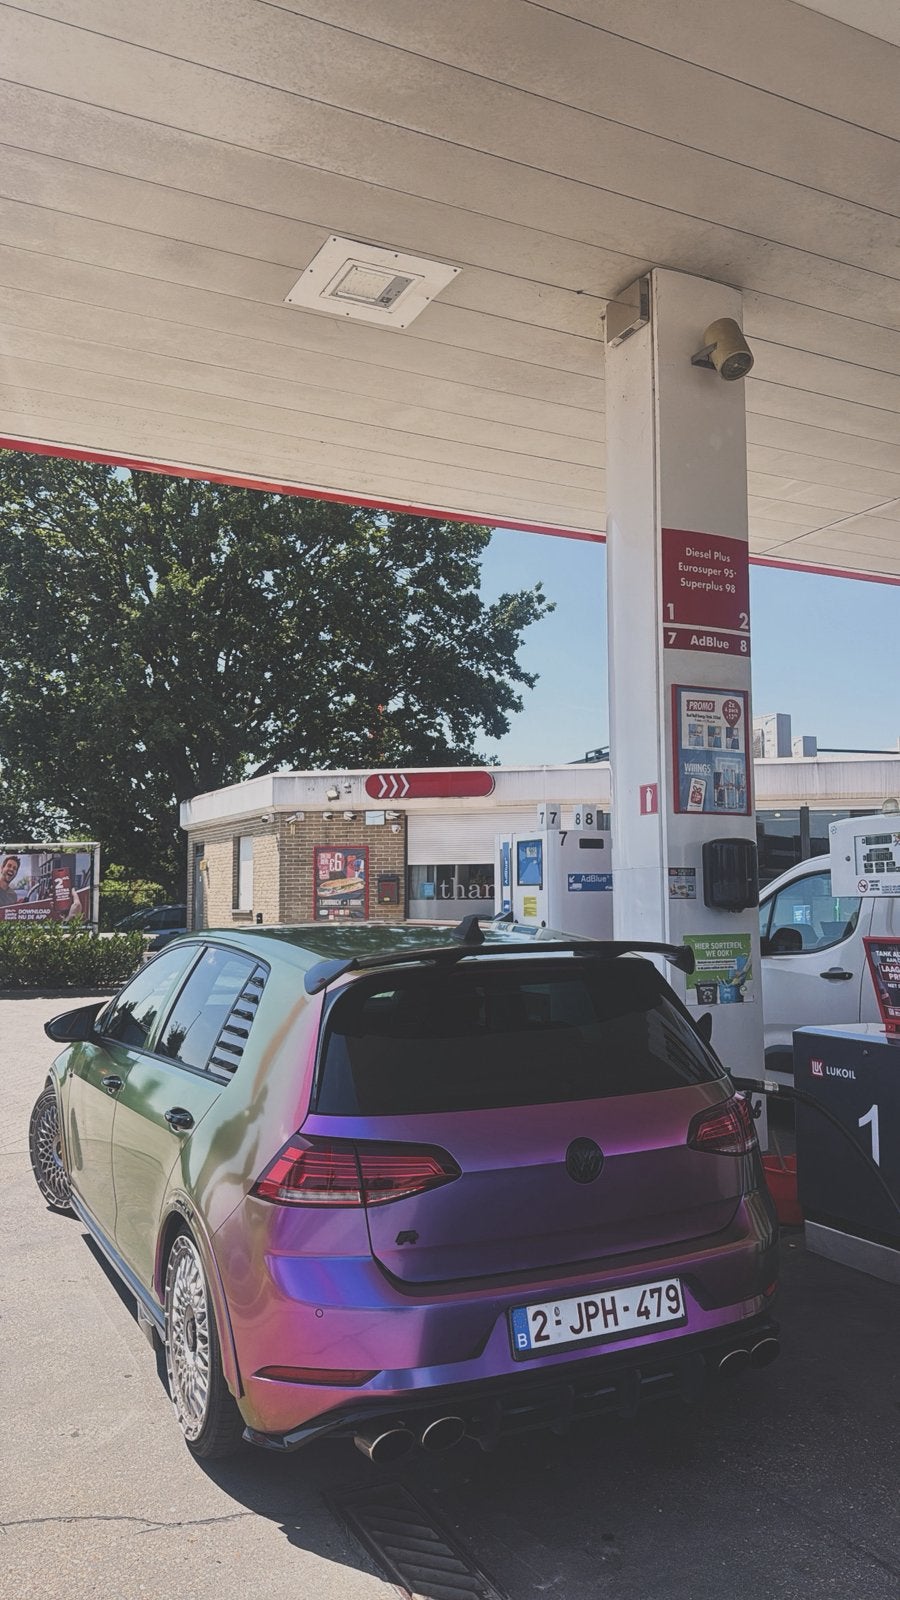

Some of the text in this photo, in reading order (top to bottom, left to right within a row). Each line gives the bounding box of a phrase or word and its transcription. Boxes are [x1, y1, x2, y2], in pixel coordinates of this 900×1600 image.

[685, 547, 731, 563] Diesel Plus
[678, 562, 722, 577] Eurosuper
[680, 578, 736, 593] Superplus 98
[666, 603, 675, 620] 1
[739, 612, 749, 630] 2
[667, 632, 748, 652] 7 AdBlue 8
[688, 701, 714, 711] PROMO
[549, 812, 557, 825] 7
[575, 813, 594, 825] 8 8
[558, 831, 568, 847] 7
[826, 1065, 857, 1080] LUKOIL
[858, 1104, 880, 1168] 1
[517, 1333, 528, 1348] B
